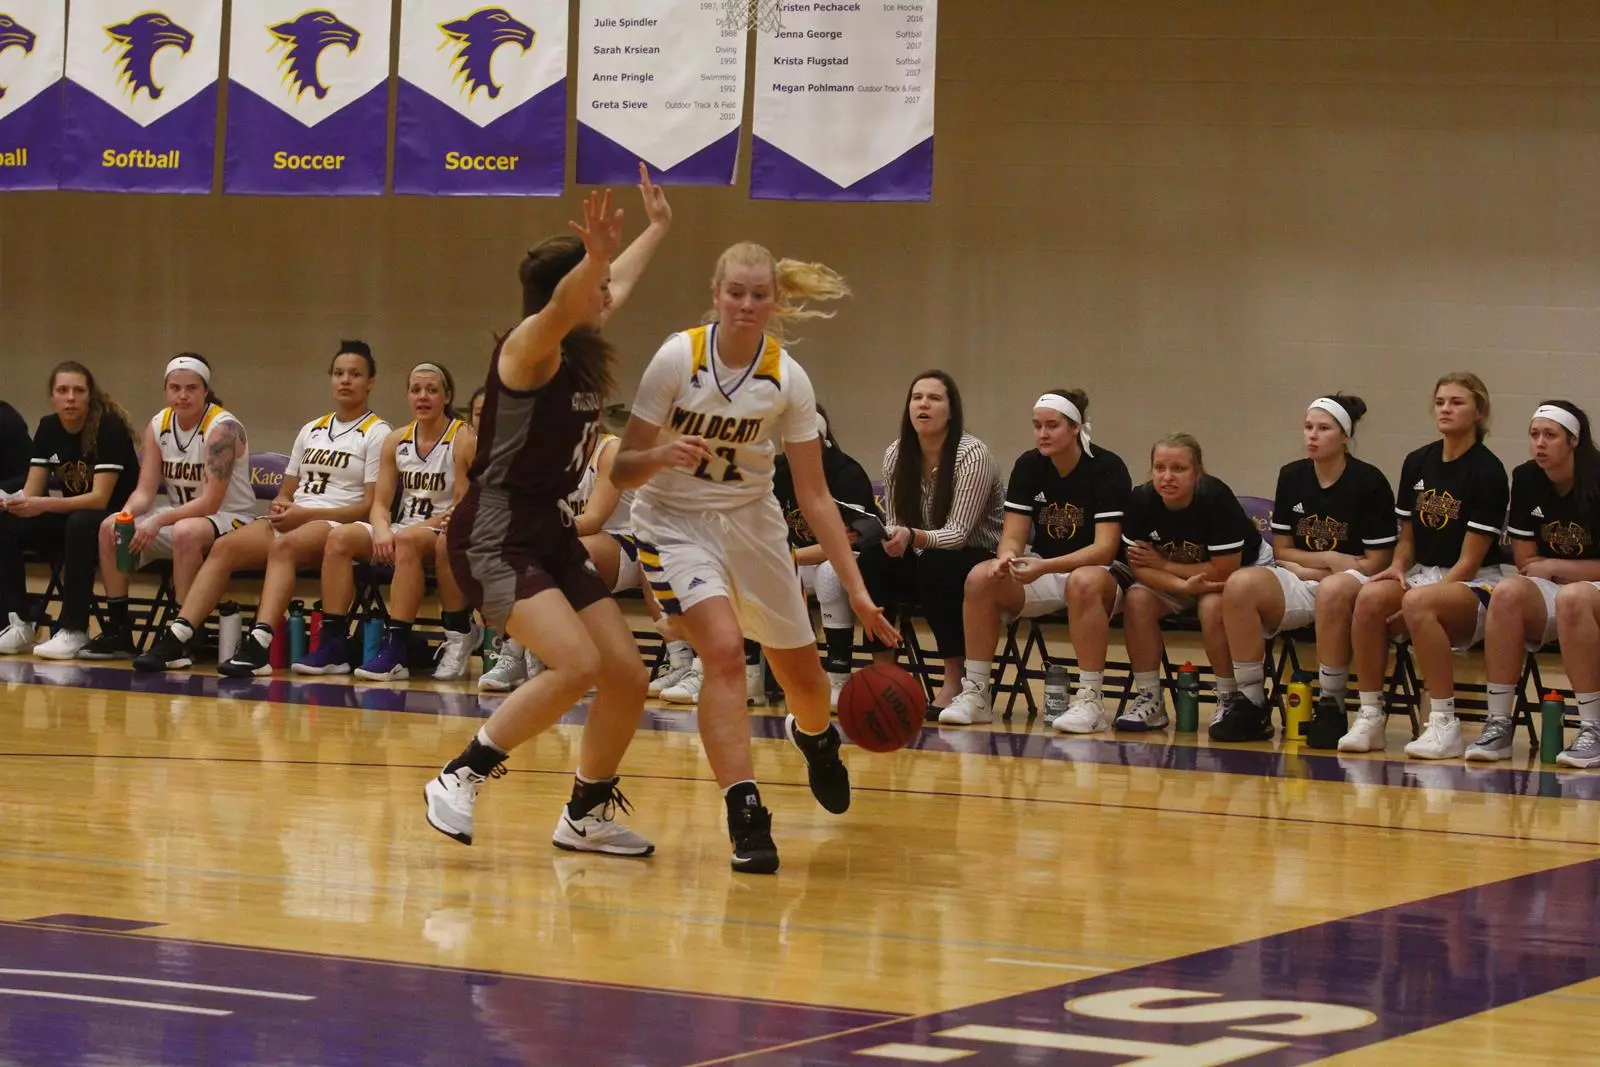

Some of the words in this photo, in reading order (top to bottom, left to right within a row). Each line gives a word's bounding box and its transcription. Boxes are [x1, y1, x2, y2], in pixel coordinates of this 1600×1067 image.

[813, 2, 861, 12] Pechacek
[897, 4, 923, 12] Hockey
[593, 18, 617, 27] Julie
[619, 18, 658, 28] Spindler
[774, 30, 804, 39] Jenna
[806, 30, 843, 40] George
[593, 45, 622, 54] Sarah
[624, 45, 660, 54] Krsiean
[715, 46, 737, 55] Diving
[720, 57, 737, 65] 1990
[773, 56, 804, 65] Krista
[807, 56, 849, 67] Flugstad
[592, 73, 618, 82] Anne
[621, 73, 654, 83] Pringle
[700, 73, 737, 83] Swimming
[772, 84, 805, 93] Megan
[807, 83, 854, 92] Pohlmann
[592, 100, 620, 109] Greta
[622, 100, 648, 109] Sieve
[665, 101, 692, 109] Outdoor
[694, 101, 711, 109] Track
[719, 112, 736, 120] 2010
[102, 148, 180, 169] Softball
[273, 150, 345, 170] Soccer
[445, 151, 520, 170] Soccer
